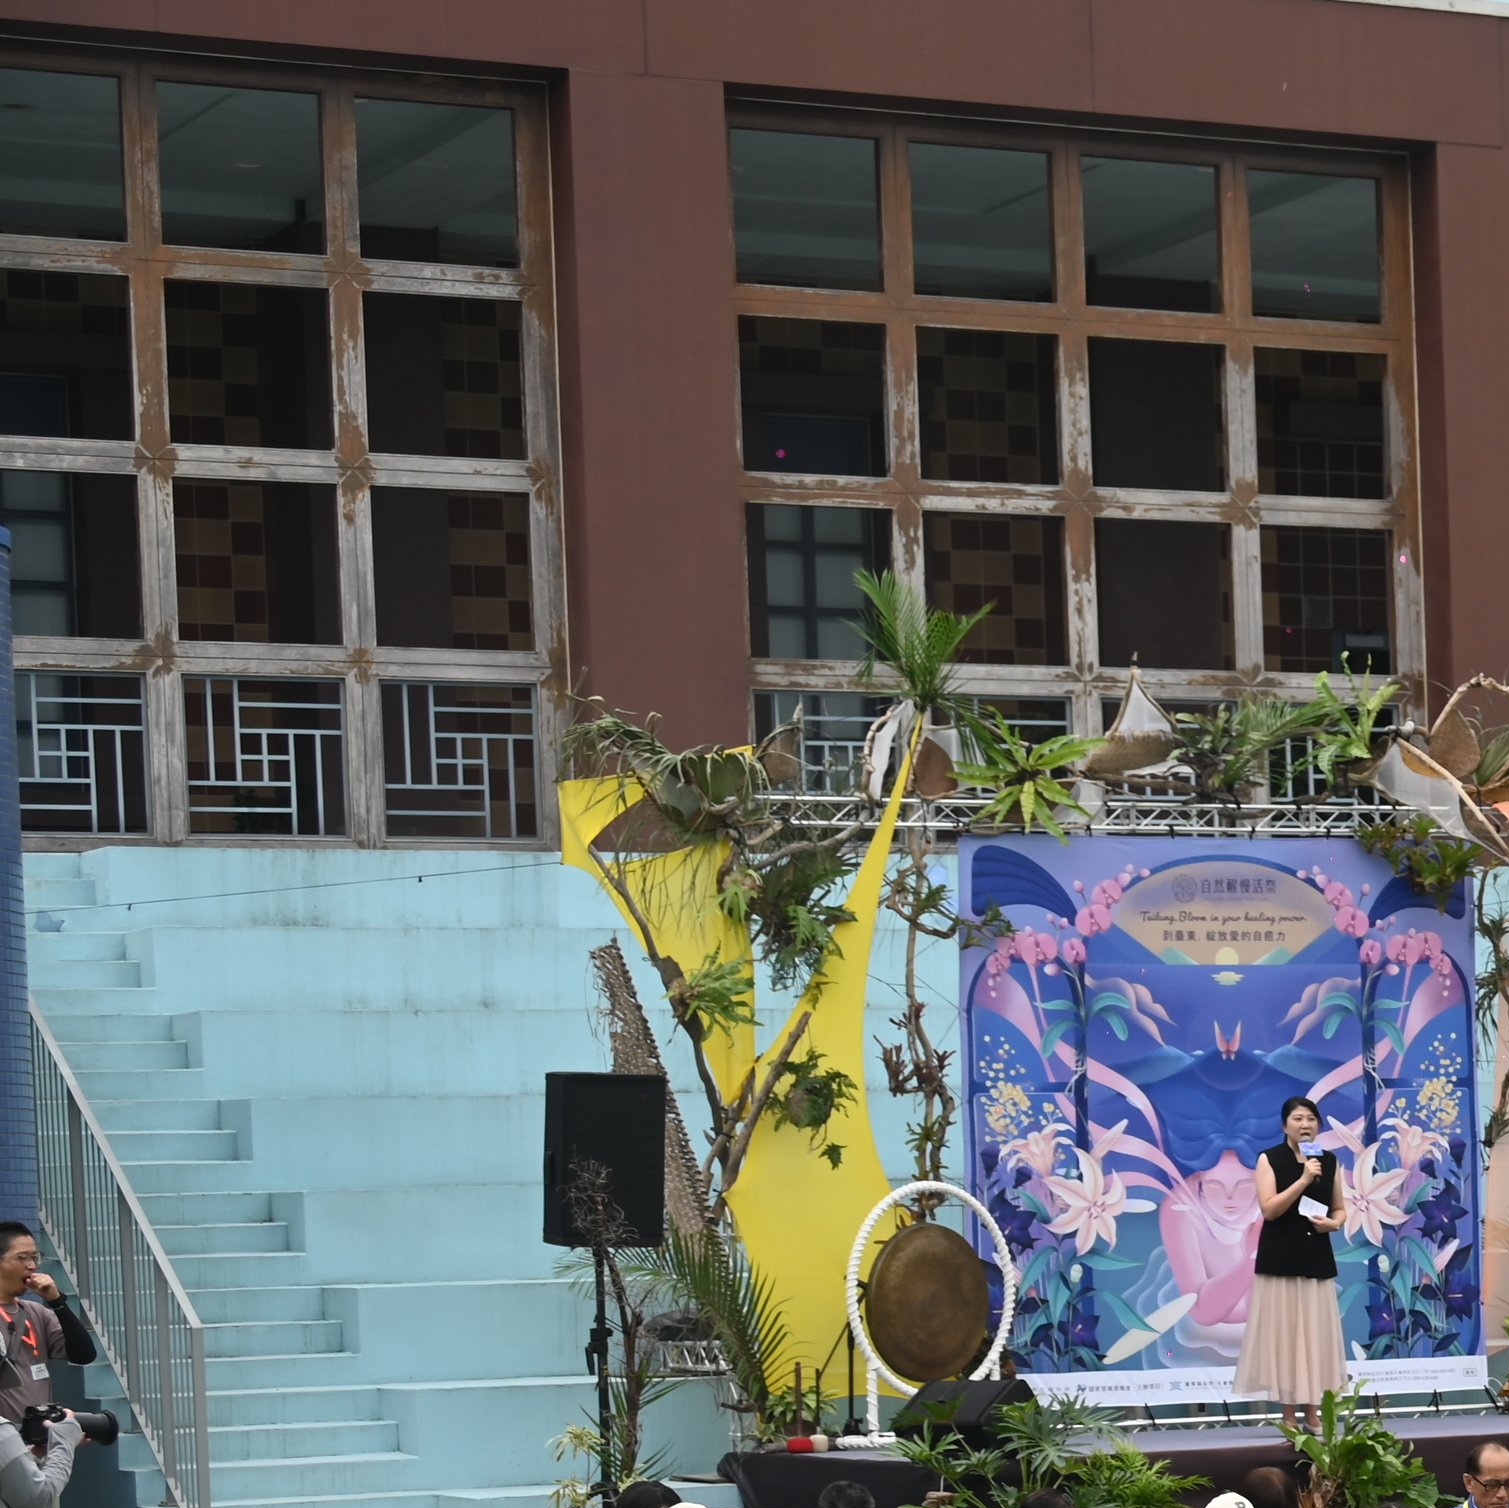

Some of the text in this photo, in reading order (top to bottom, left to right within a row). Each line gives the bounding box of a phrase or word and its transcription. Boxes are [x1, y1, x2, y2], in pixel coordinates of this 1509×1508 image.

[1179, 910, 1207, 922] Bloom
[1210, 913, 1219, 922] in
[1221, 914, 1242, 926] your
